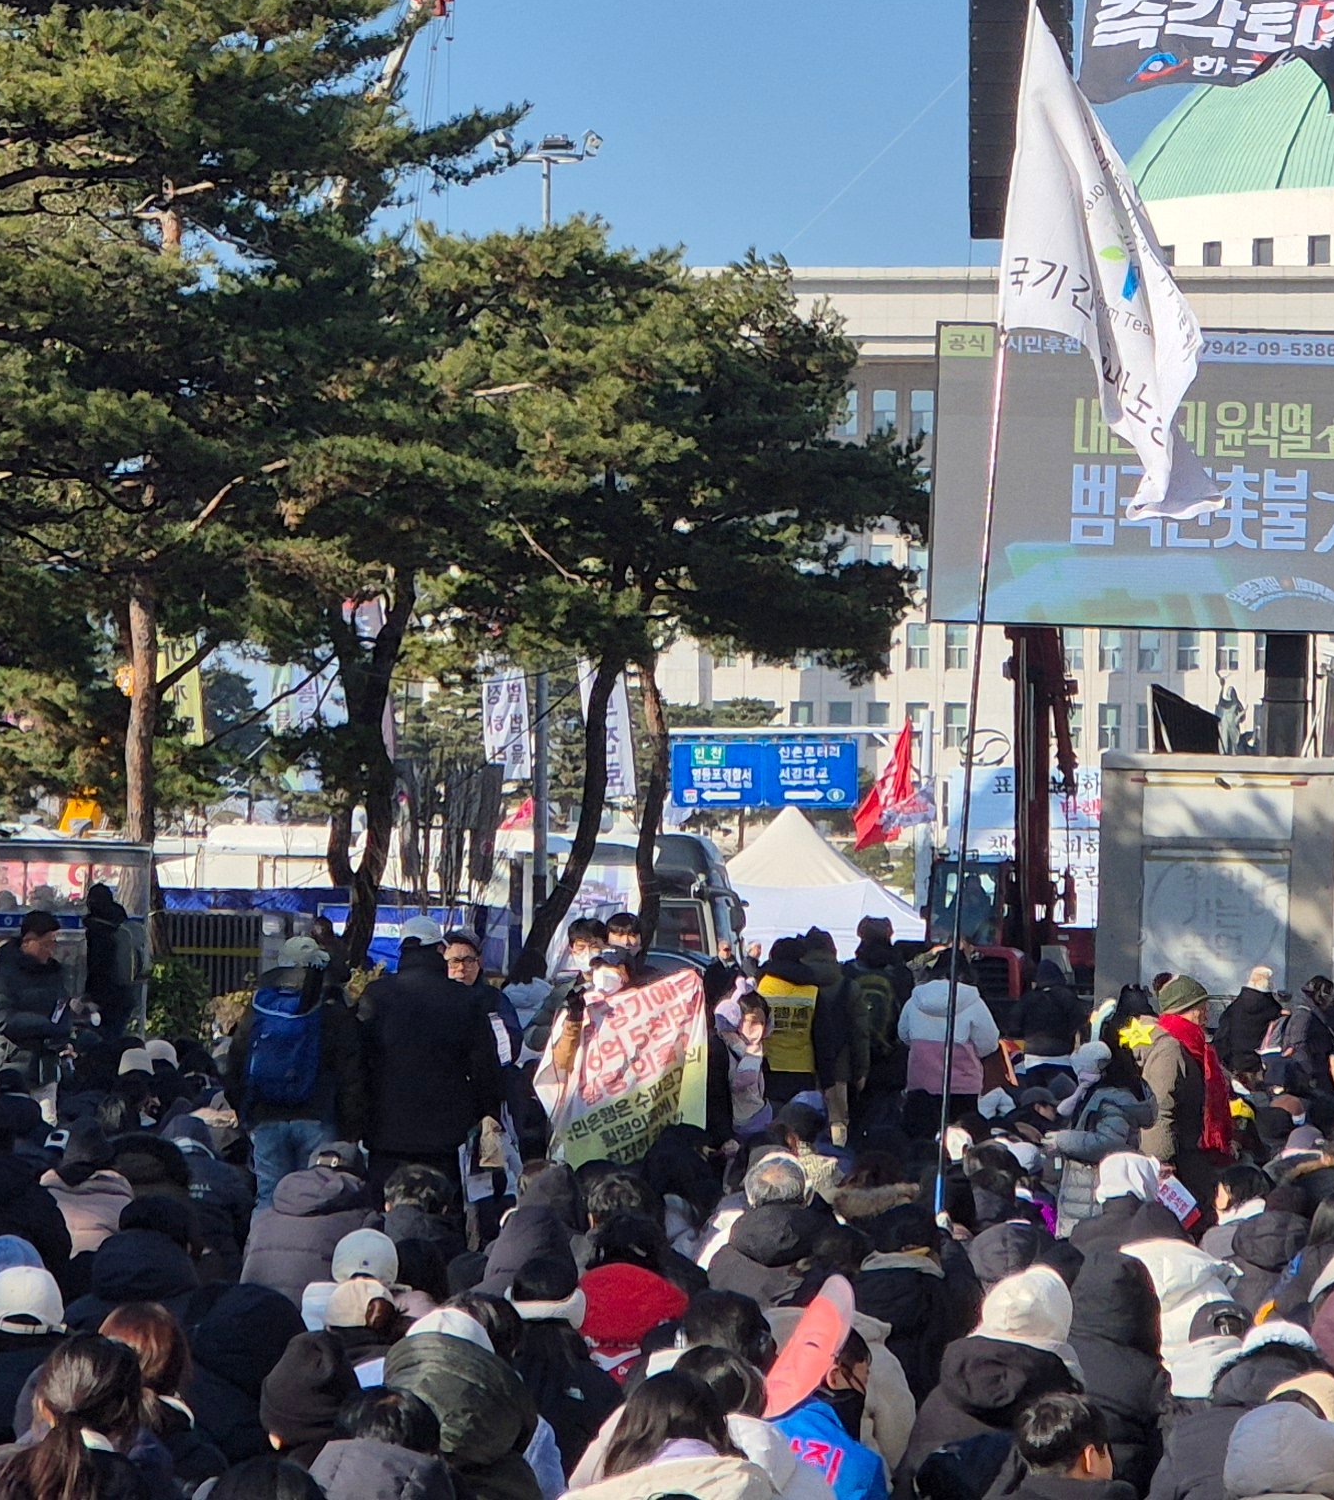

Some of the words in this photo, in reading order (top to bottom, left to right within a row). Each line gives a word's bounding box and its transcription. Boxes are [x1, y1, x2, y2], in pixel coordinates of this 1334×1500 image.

[948, 333, 985, 352] 공식
[1007, 334, 1082, 355] 시민후원
[1215, 401, 1313, 459] 윤석열
[567, 1098, 634, 1142] 민은행은
